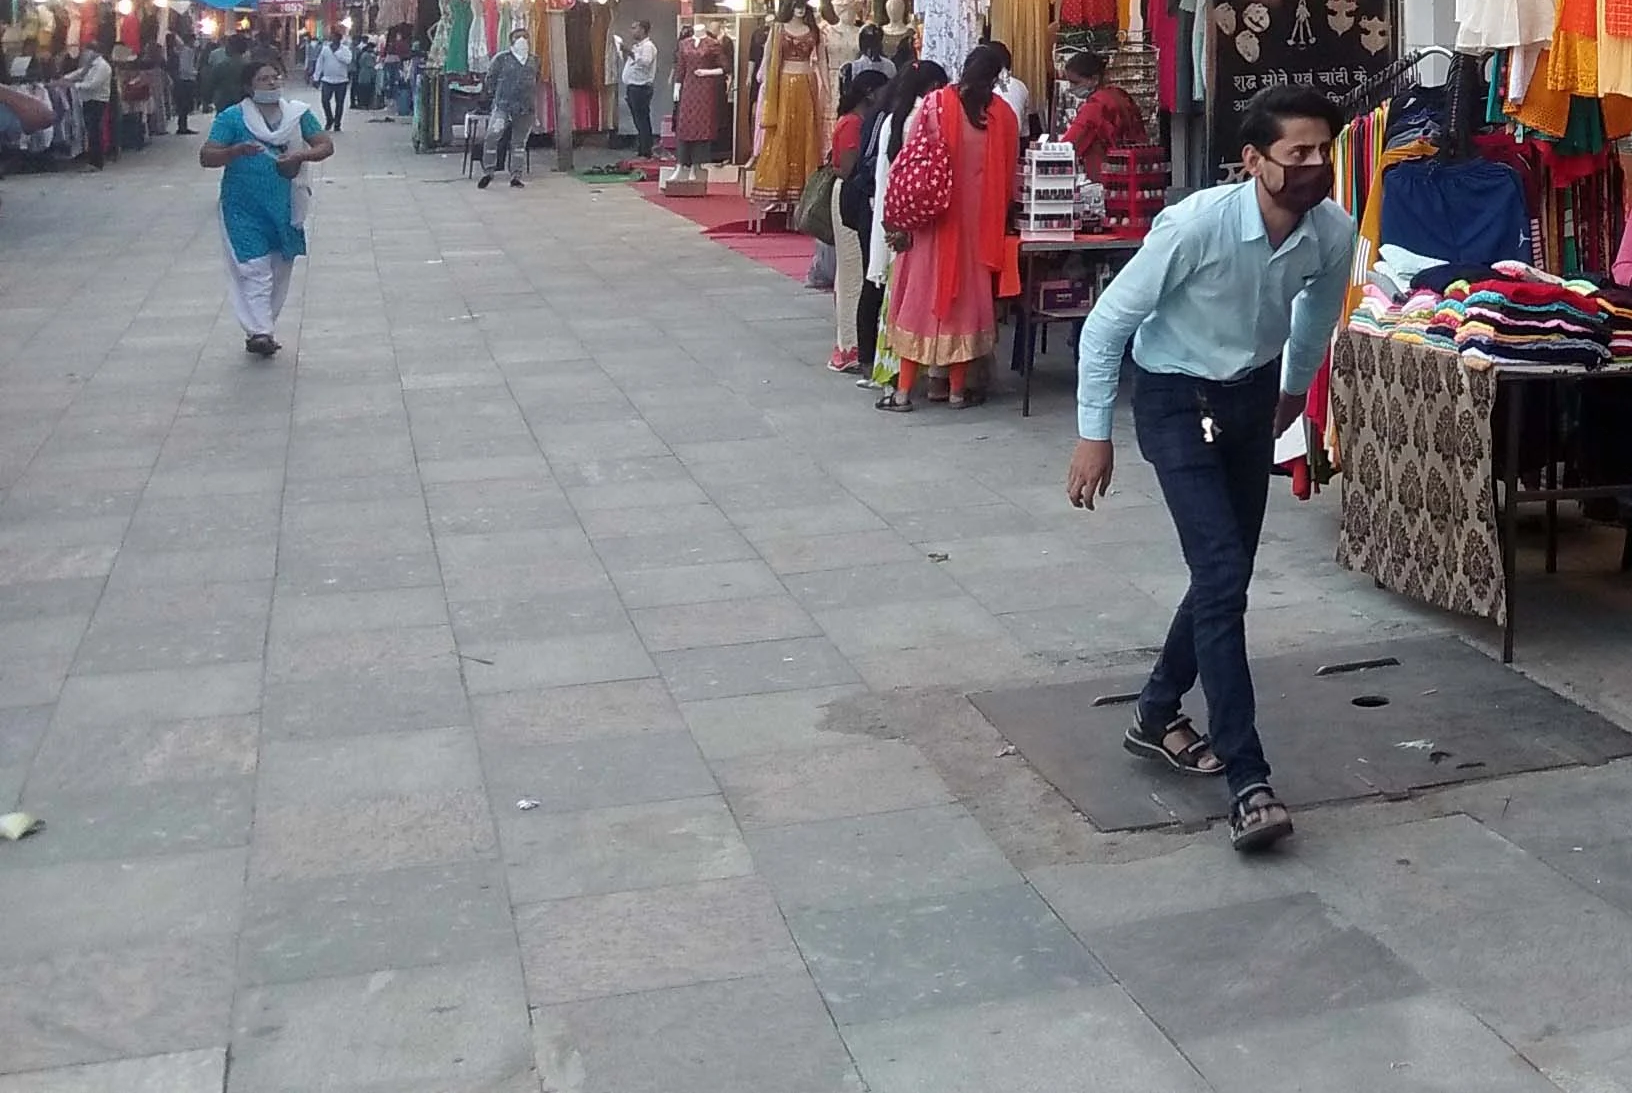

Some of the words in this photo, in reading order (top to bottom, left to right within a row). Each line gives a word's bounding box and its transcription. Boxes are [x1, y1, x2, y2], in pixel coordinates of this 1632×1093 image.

[1233, 74, 1257, 93] शुद्ध
[1260, 68, 1288, 87] सोने
[1292, 68, 1314, 87] एवं
[1317, 67, 1350, 86] चांदी
[1353, 66, 1367, 84] के
